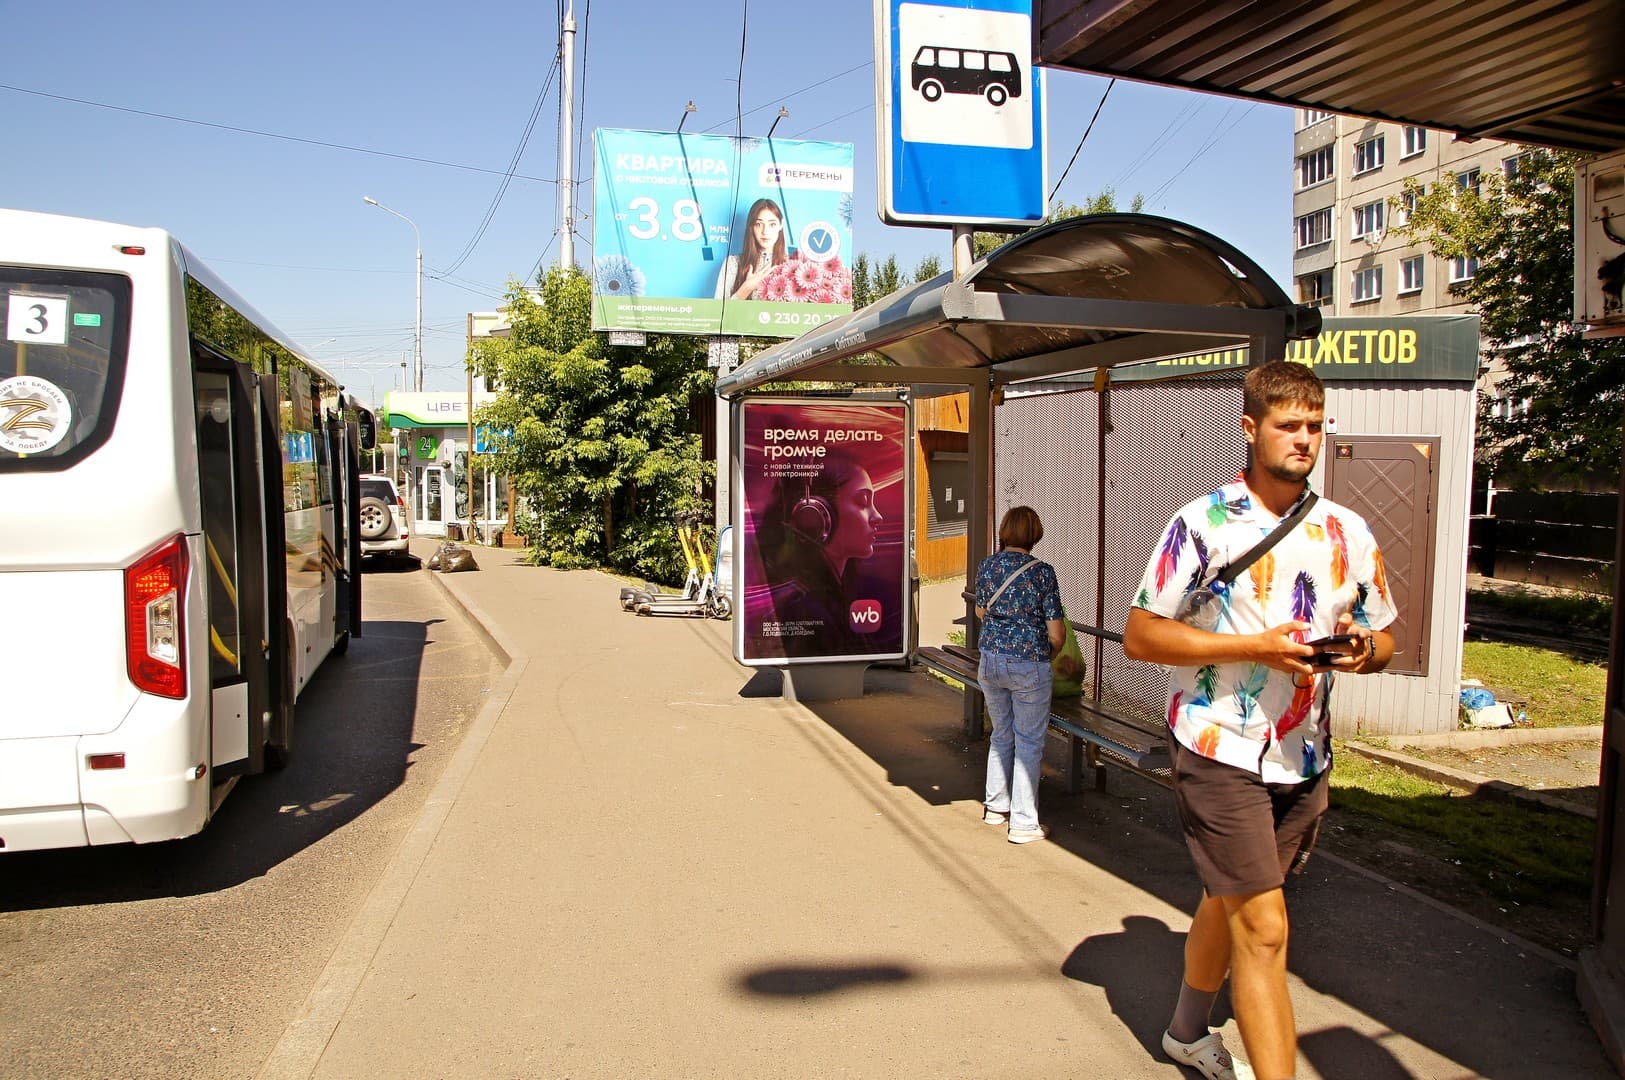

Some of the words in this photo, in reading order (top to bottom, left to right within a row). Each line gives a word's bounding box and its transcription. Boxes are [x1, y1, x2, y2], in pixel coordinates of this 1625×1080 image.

[616, 153, 728, 175] КВАРТИРА
[785, 169, 842, 181] ПЕРЕМЕНЫ
[628, 196, 704, 242] 3.8
[25, 303, 49, 335] 3
[775, 312, 800, 325] 230
[803, 313, 821, 325] 20
[420, 436, 432, 451] 24
[763, 428, 819, 444] время
[824, 429, 884, 443] делать
[763, 445, 827, 461] громче
[770, 462, 791, 470] новой
[793, 462, 825, 470] техникой
[770, 470, 819, 479] электроникой
[851, 606, 880, 624] wb
